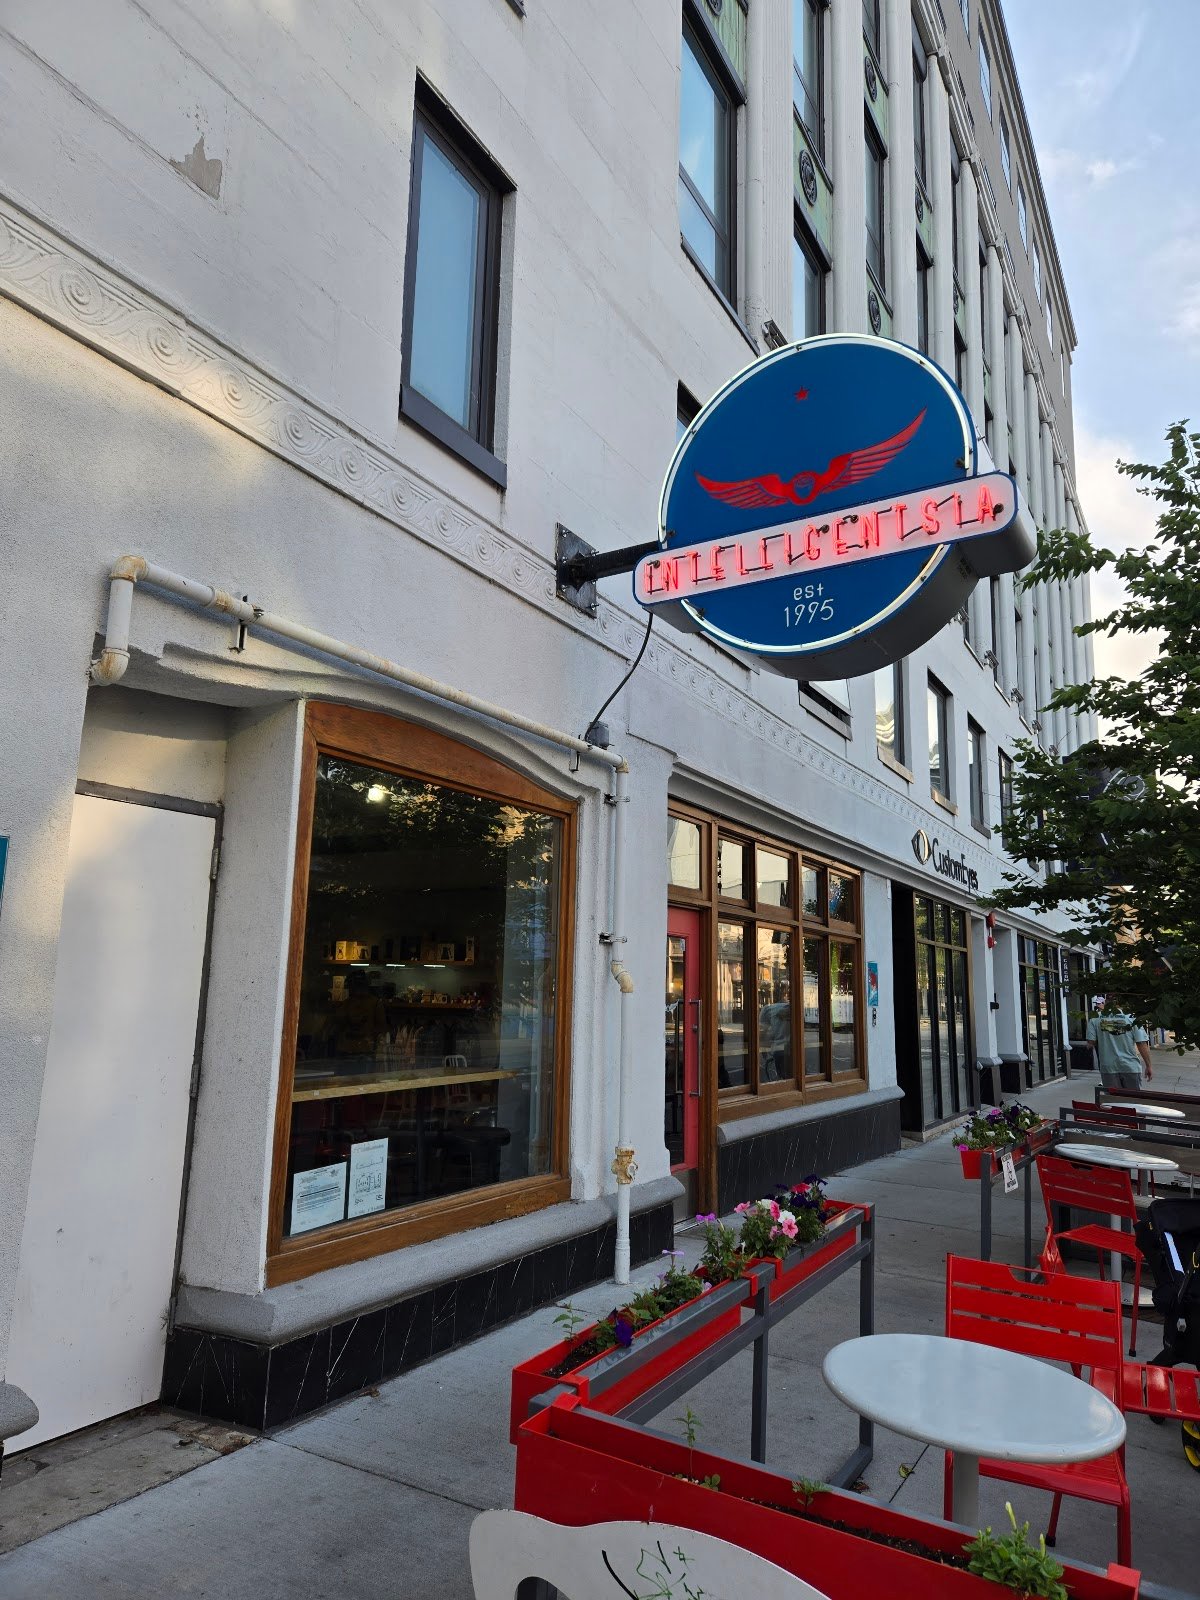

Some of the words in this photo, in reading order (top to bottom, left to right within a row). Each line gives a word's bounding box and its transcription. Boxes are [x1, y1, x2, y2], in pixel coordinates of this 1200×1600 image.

[793, 582, 824, 601] est
[783, 598, 834, 628] 1995
[932, 837, 979, 895] CustomEyes
